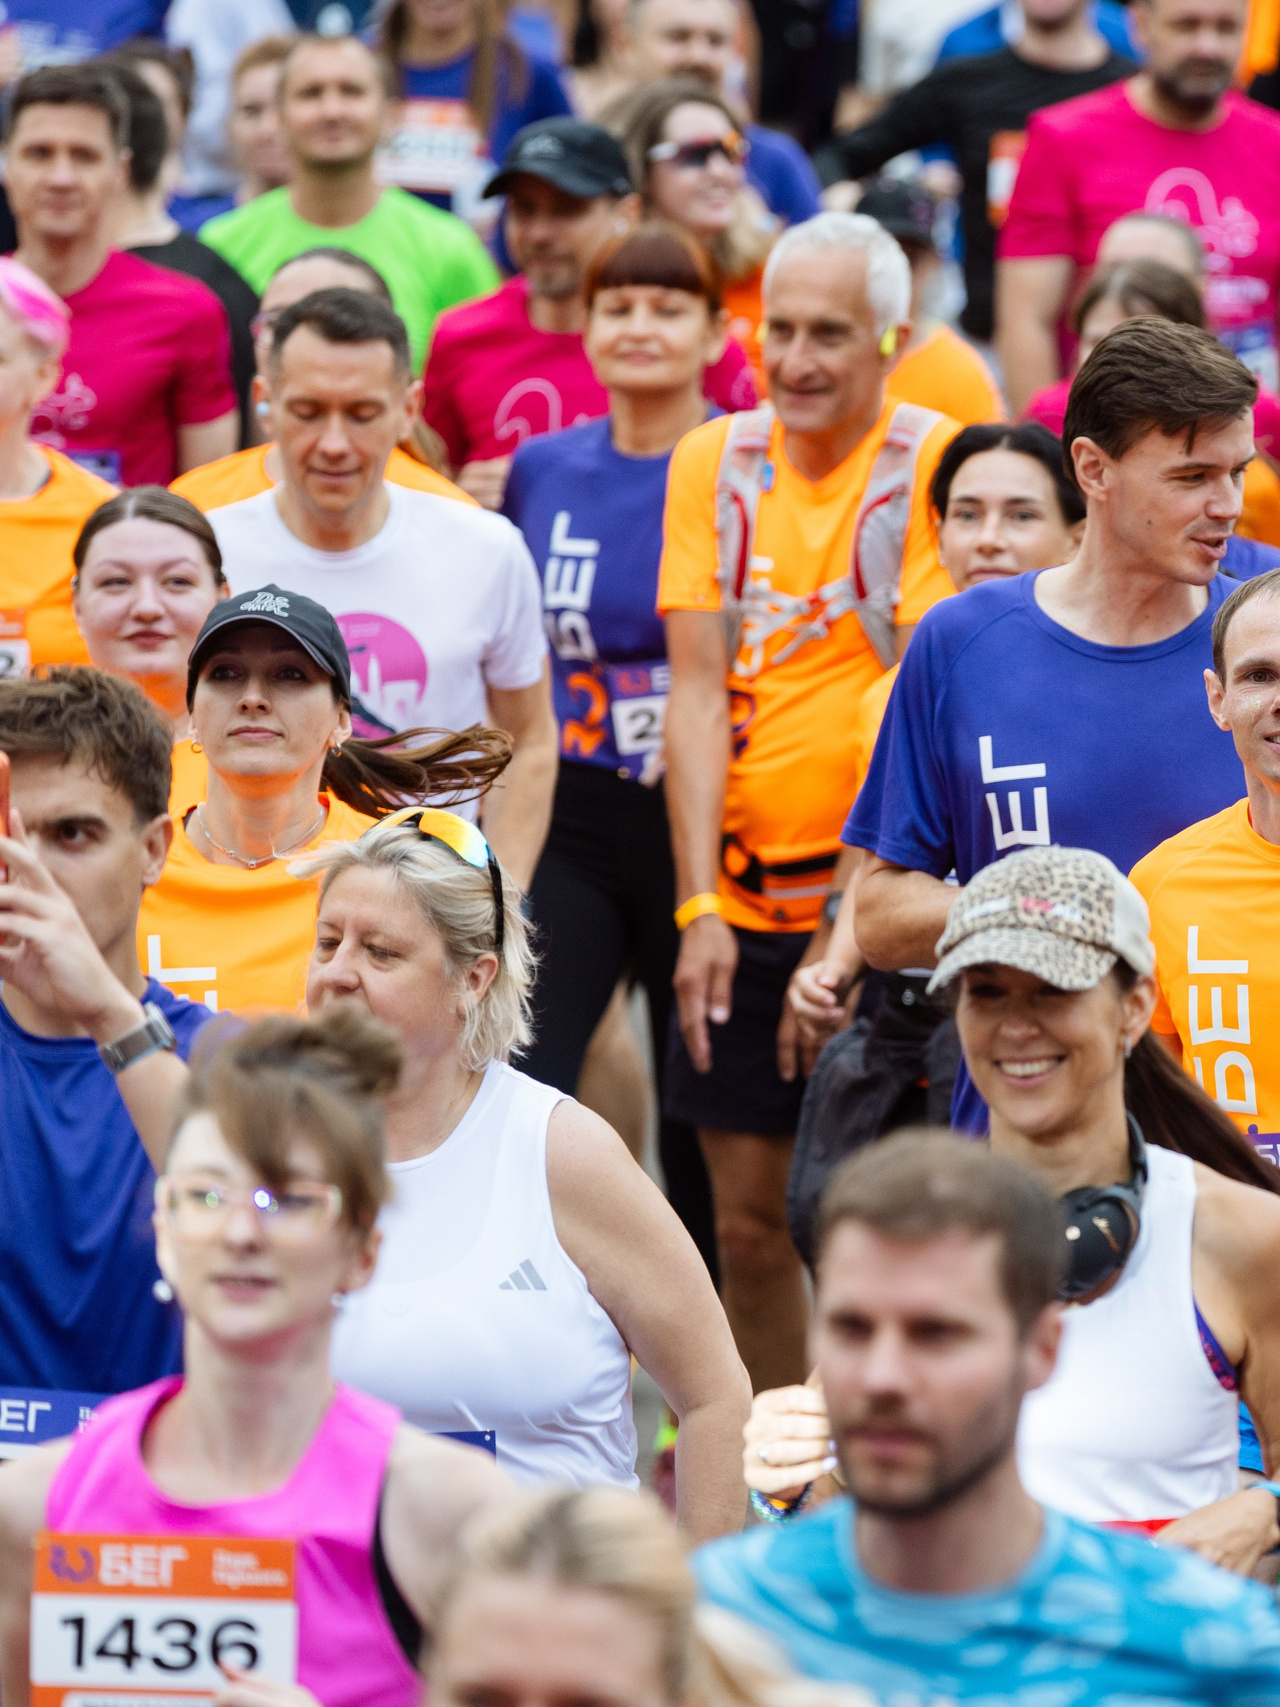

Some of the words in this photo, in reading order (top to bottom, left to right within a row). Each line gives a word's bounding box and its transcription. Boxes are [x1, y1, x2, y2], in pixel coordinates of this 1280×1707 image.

[1187, 925, 1258, 1115] БЕГ
[99, 1543, 188, 1588] БЕГ
[60, 1614, 260, 1672] 1436
